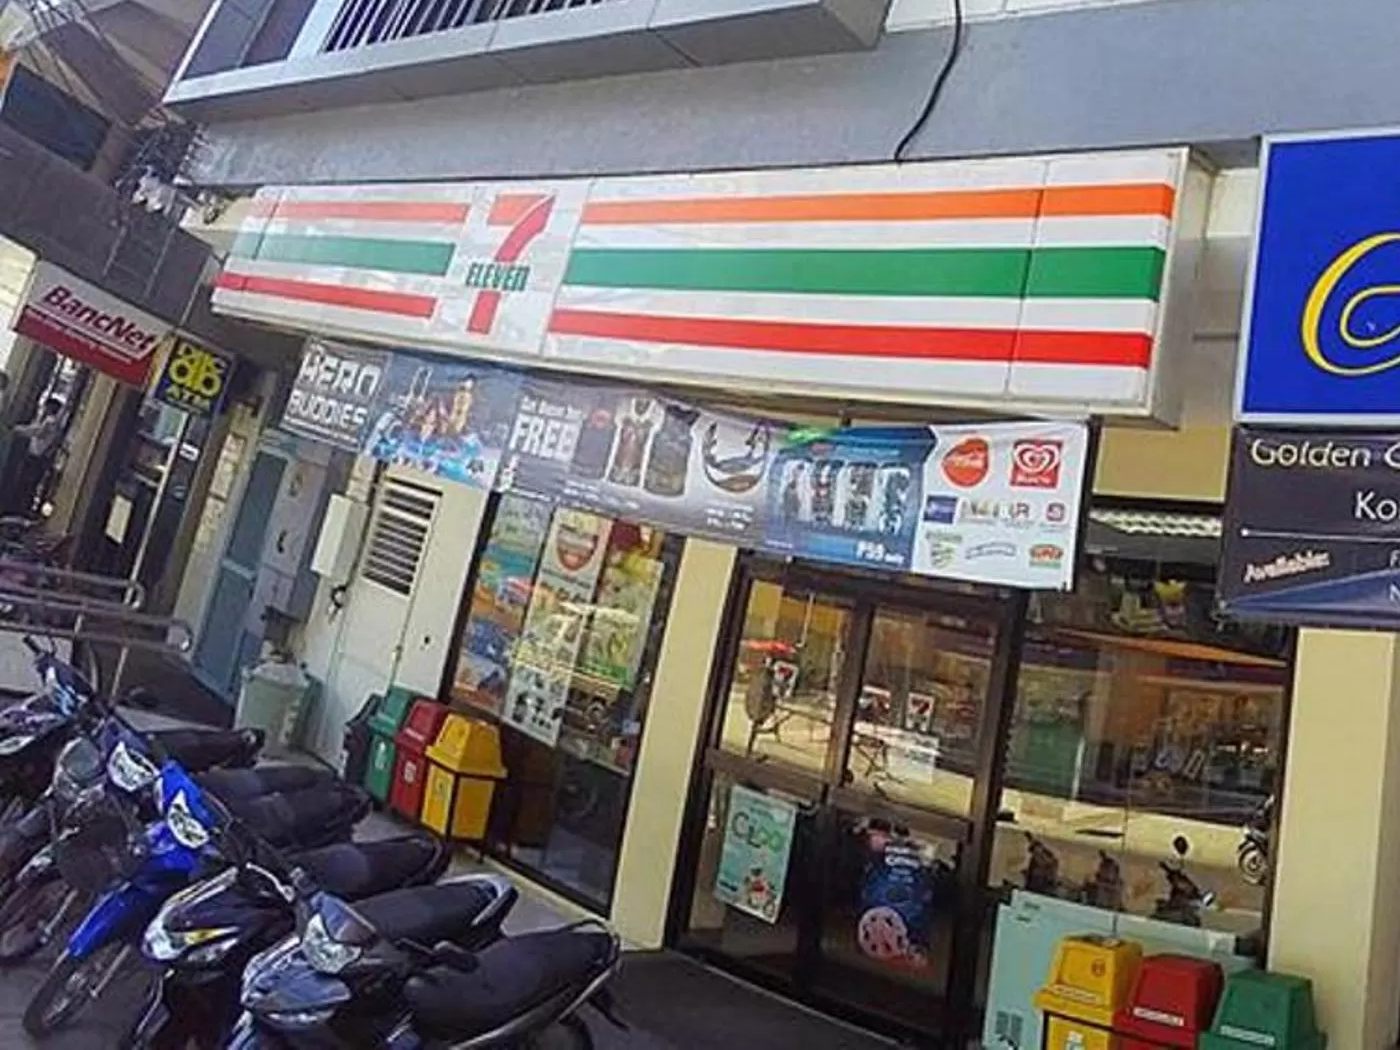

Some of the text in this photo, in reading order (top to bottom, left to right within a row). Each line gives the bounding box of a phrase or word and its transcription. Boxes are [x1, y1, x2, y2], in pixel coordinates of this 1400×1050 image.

[465, 194, 556, 335] 7
[44, 286, 155, 352] BancNet
[508, 412, 583, 463] FREE
[1251, 439, 1370, 468] Golden
